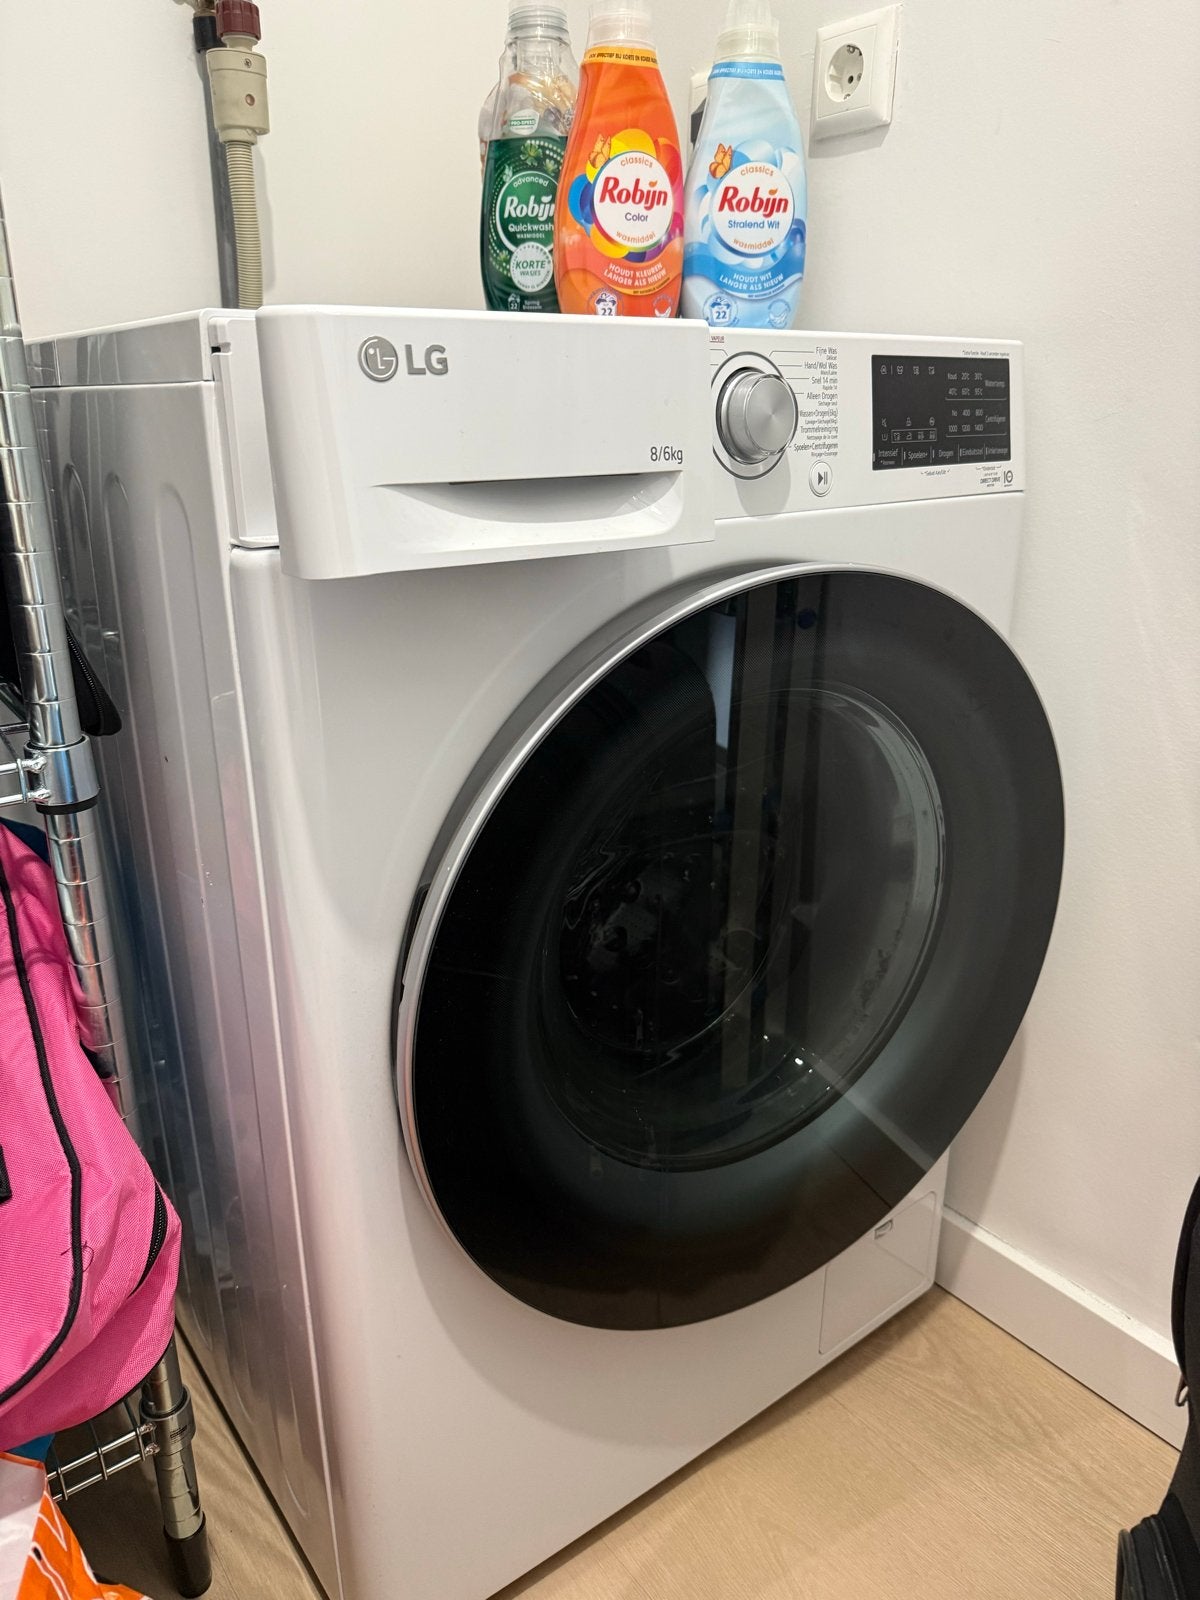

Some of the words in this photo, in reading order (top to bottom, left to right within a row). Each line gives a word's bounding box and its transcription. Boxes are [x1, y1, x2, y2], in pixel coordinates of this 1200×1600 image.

[620, 157, 653, 168] classics
[740, 165, 774, 176] classics
[513, 176, 549, 188] advanced
[599, 176, 668, 211] Robijn
[718, 186, 789, 218] Robijn
[624, 212, 649, 222] Color
[508, 223, 554, 232] Quickwash
[728, 220, 764, 229] Stralend
[767, 220, 780, 229] Wit
[616, 230, 656, 244] wasmiddel
[733, 238, 774, 250] wasmiddel
[516, 260, 546, 270] KORTE
[608, 262, 634, 278] HOUDT
[636, 262, 663, 278] KLEUREN
[604, 269, 633, 286] LANGER
[634, 278, 647, 286] ALS
[648, 268, 667, 284] NIEUW
[733, 273, 758, 285] HOUDT
[759, 272, 772, 282] WIT
[719, 274, 748, 291] LANGER
[749, 283, 762, 292] ALS
[764, 274, 784, 289] NIEUW
[600, 308, 613, 316] 22
[715, 310, 727, 320] 22
[816, 346, 827, 356] Fijne
[828, 346, 838, 354] Was
[405, 344, 449, 376] LG
[804, 361, 828, 370] Hand/Wol
[828, 362, 838, 370] Was
[812, 376, 822, 384] Snel
[822, 392, 838, 402] Drogen
[650, 446, 683, 465] 8/6kg
[878, 448, 898, 458] Intensief
[908, 451, 928, 460] Spoelen+
